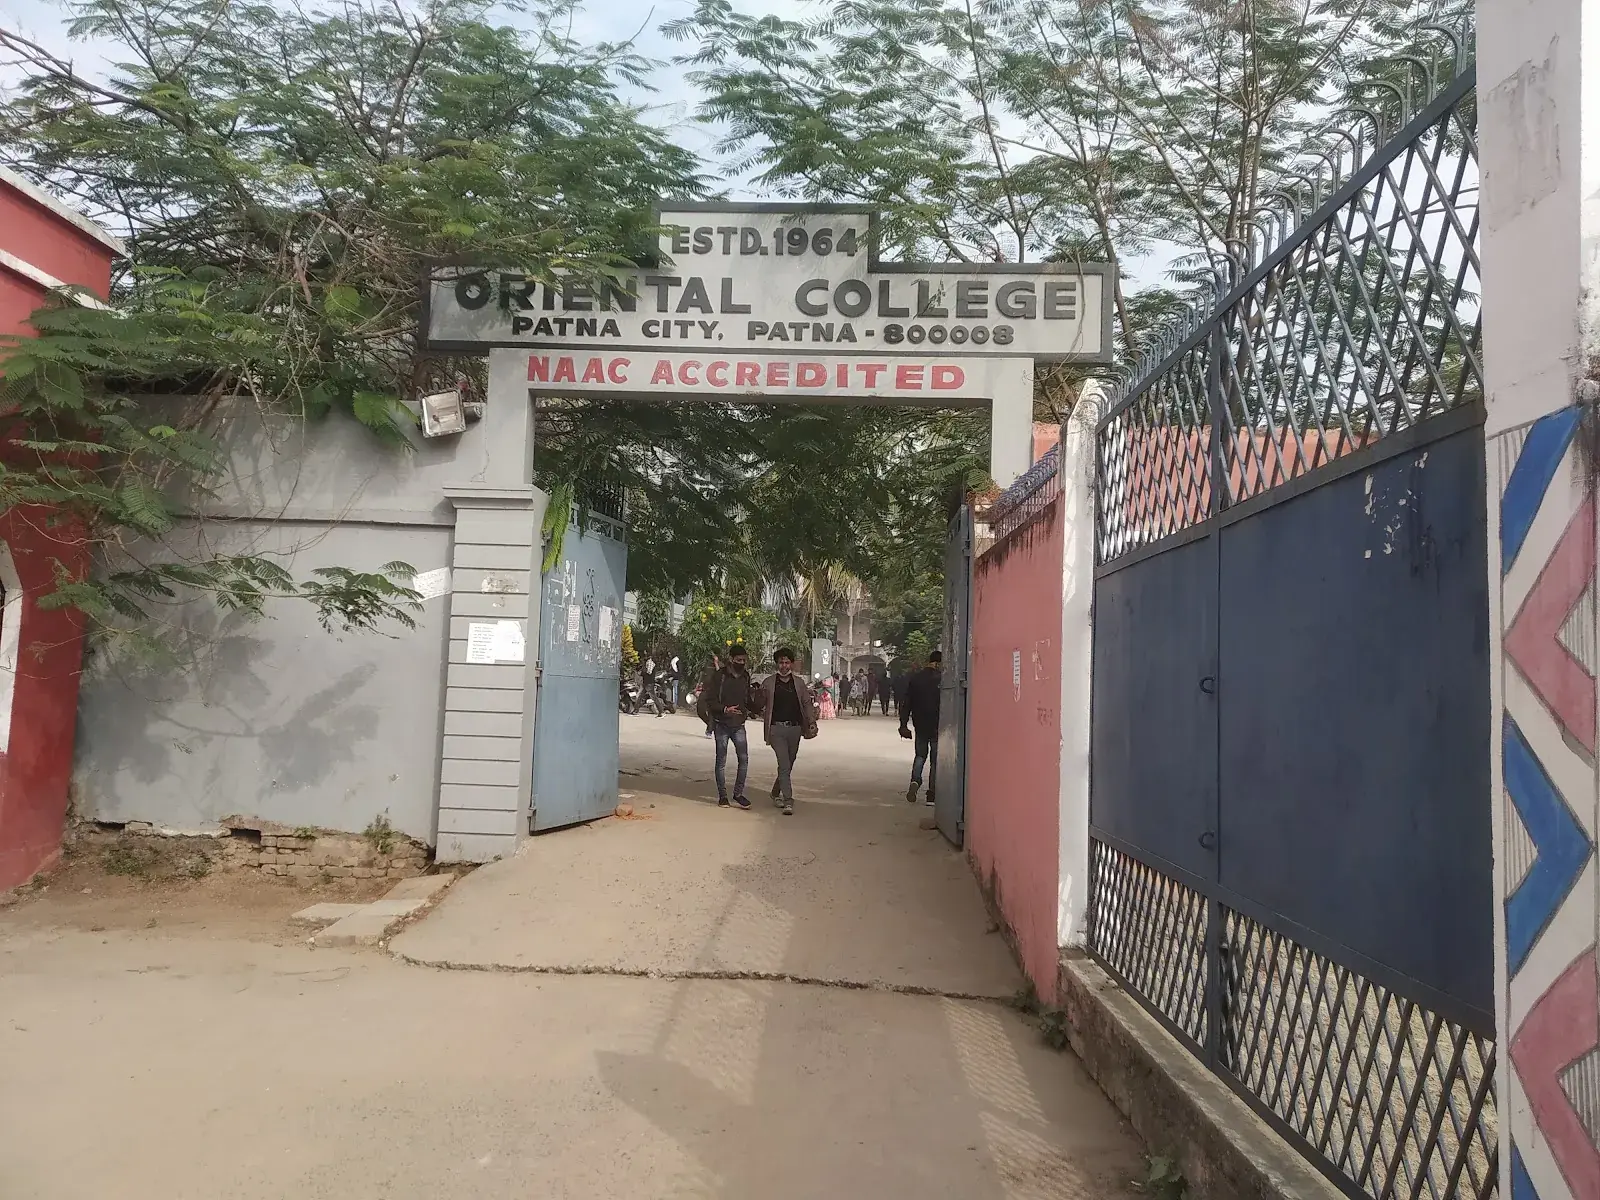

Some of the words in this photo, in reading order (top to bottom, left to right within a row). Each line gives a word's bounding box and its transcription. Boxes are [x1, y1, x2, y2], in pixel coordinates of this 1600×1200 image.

[454, 270, 752, 314] ORIENTAL
[795, 278, 1077, 321] COLLEGE
[511, 316, 621, 337] PATNA
[641, 319, 724, 340] CITY,
[526, 355, 631, 384] NAAC
[650, 358, 965, 391] ACCREDITED
